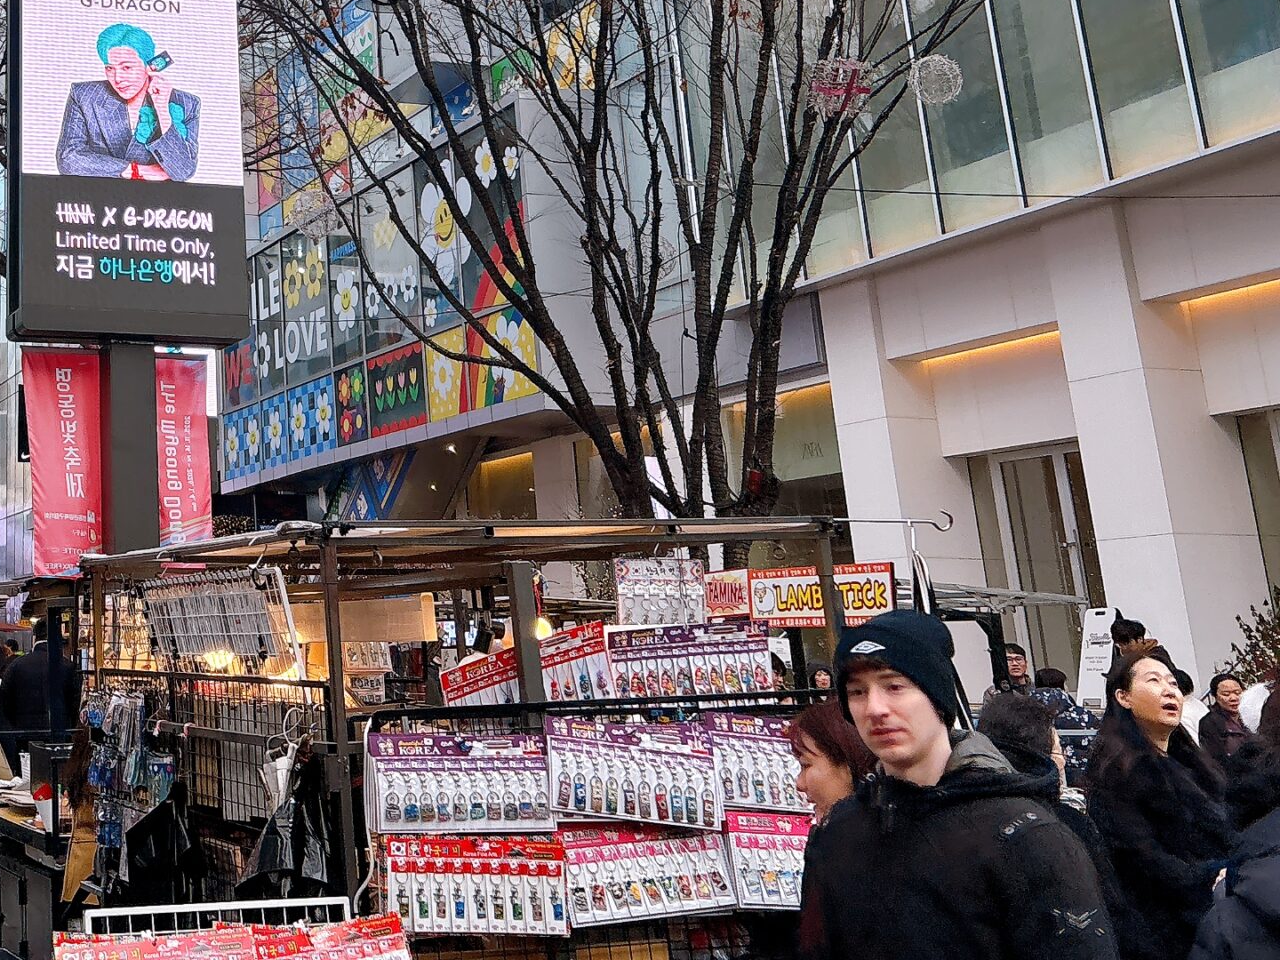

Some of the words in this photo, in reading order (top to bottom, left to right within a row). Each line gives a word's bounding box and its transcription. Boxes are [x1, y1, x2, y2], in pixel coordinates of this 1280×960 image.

[102, 206, 117, 227] X
[123, 206, 213, 232] G-DRAGON
[56, 231, 120, 251] Limited
[124, 234, 167, 253] Time
[171, 237, 215, 258] Only,
[56, 255, 94, 280] 지금
[99, 256, 216, 285] 하나은행에서!
[224, 343, 253, 390] WE
[274, 306, 328, 370] LOVE
[705, 581, 744, 604] TAMINA
[775, 580, 823, 612] LAMB
[836, 578, 888, 610] TICK
[632, 635, 670, 646] KOREA
[466, 661, 504, 680] KOREA
[572, 728, 611, 741] KOREA
[732, 723, 770, 736] KOREA
[399, 745, 441, 755] KOREA
